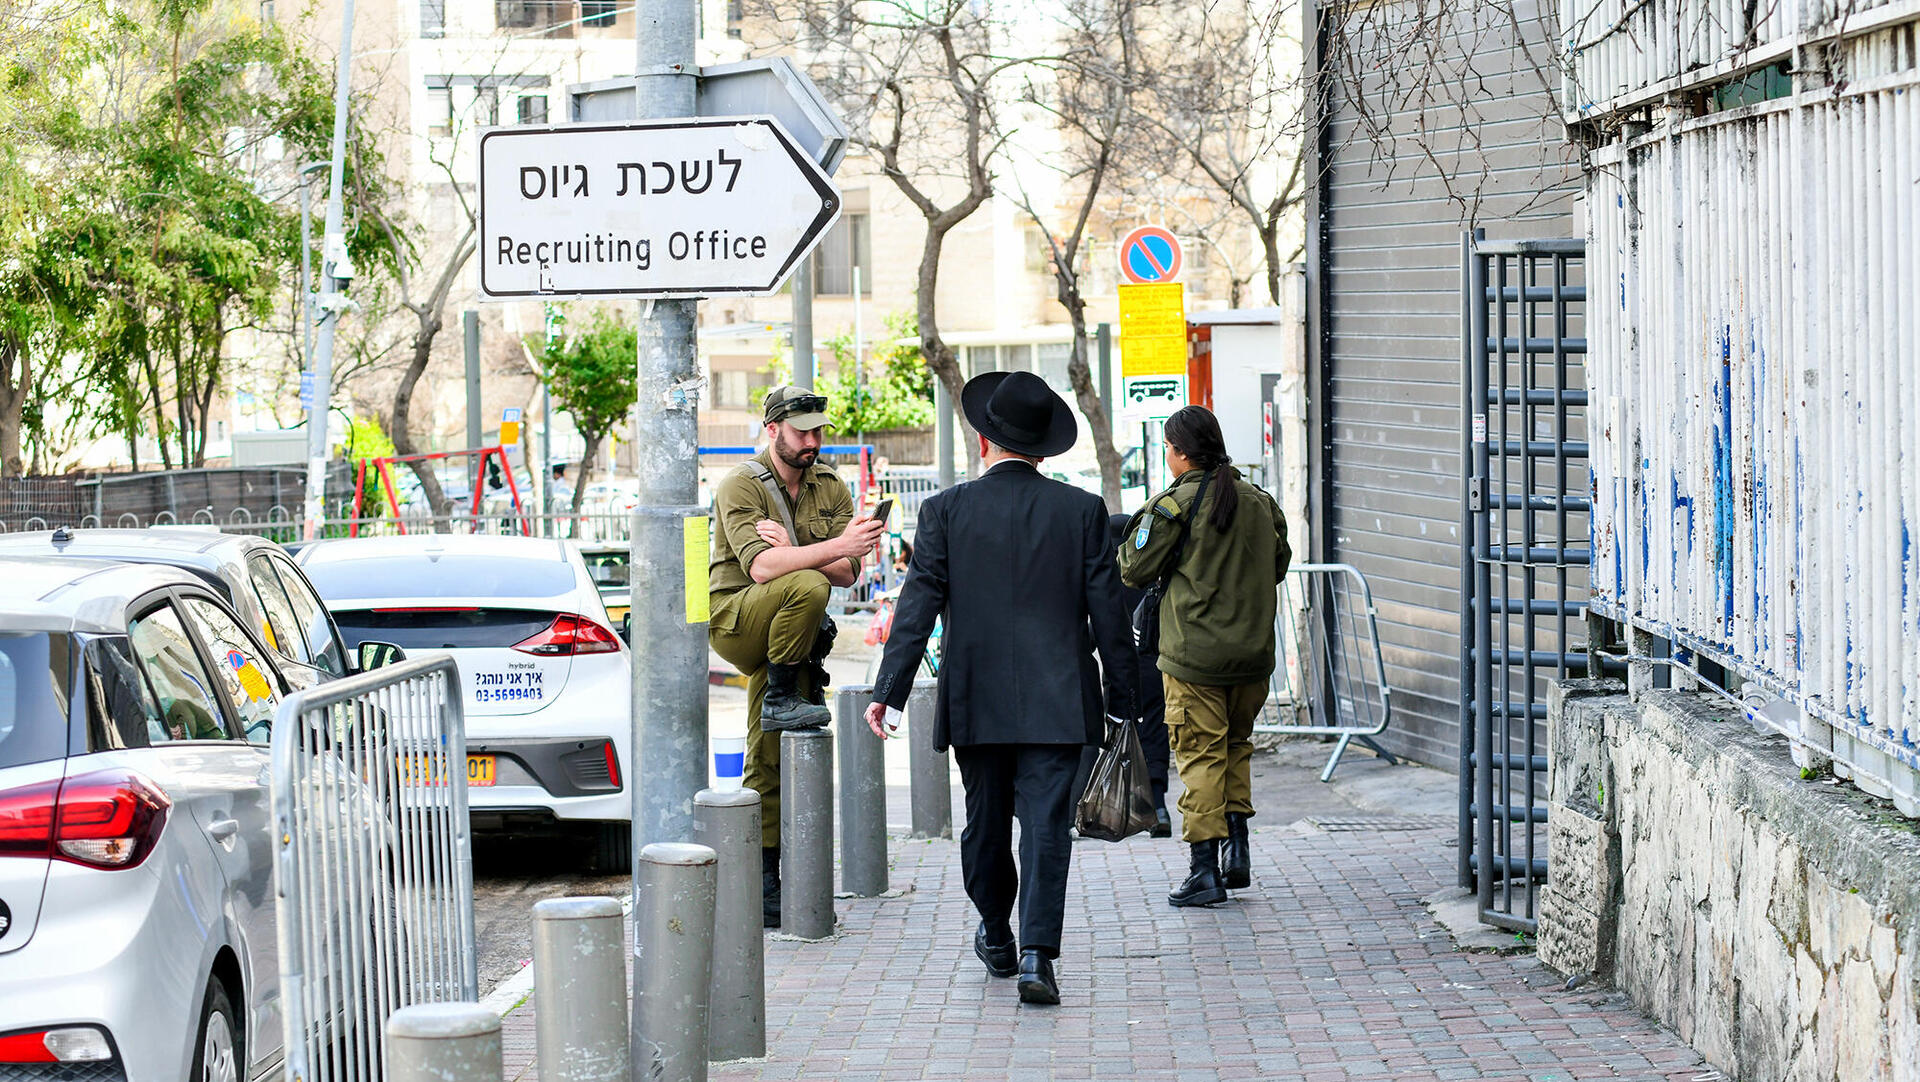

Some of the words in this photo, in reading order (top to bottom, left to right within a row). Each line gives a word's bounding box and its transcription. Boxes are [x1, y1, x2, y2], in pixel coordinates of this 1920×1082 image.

[616, 148, 742, 197] לשכת
[519, 164, 590, 200] גיוס
[498, 232, 651, 271] Recruiting
[668, 229, 767, 261] Office
[508, 662, 535, 670] hybrid
[475, 673, 503, 685] נוהג?
[506, 672, 522, 684] אני
[525, 672, 543, 686] איך
[475, 688, 543, 702] 03-5699403
